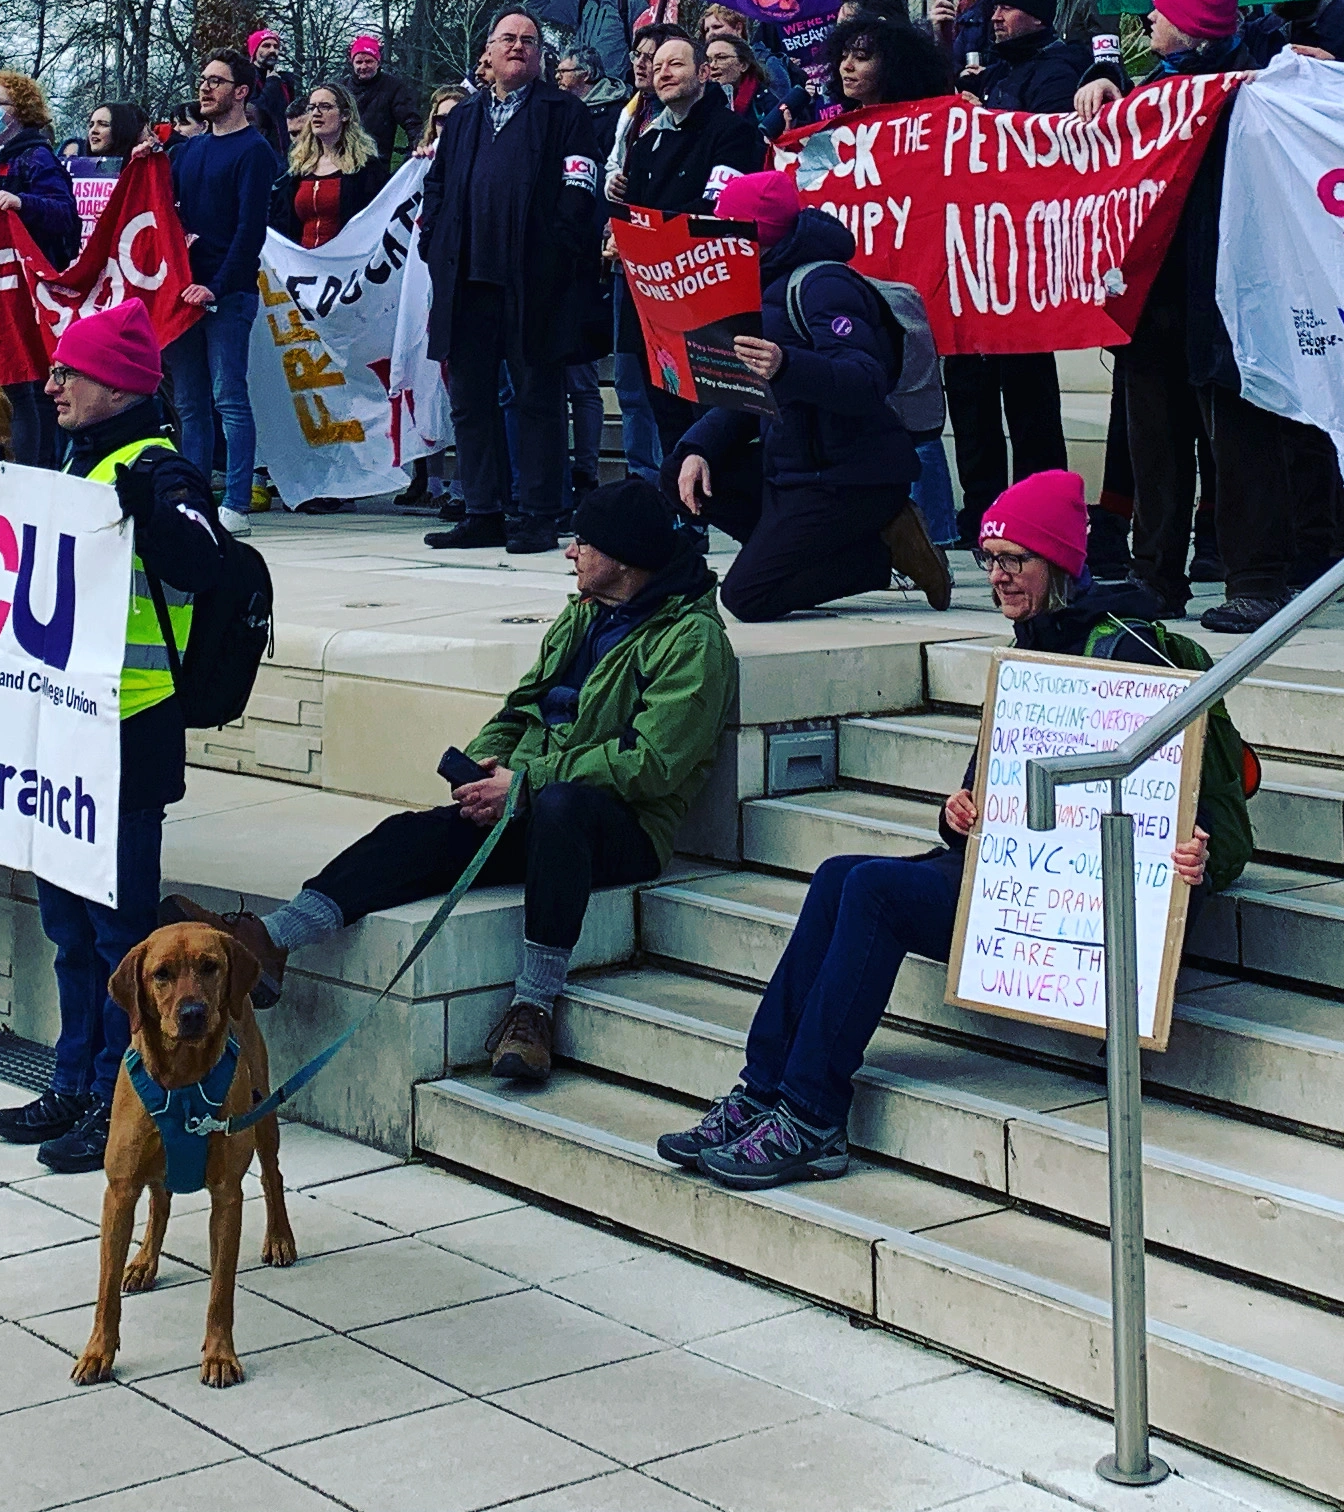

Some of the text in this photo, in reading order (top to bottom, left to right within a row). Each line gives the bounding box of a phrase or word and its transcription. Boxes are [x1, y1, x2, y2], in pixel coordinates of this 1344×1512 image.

[887, 112, 932, 157] THE
[944, 98, 1124, 178] PENSION
[625, 236, 755, 283] FOUR FIGHTS
[945, 202, 1017, 317] NO
[636, 263, 731, 302] ONE VOICE
[0, 669, 24, 691] and
[66, 685, 97, 716] Union
[1001, 666, 1031, 691] OUR
[1034, 672, 1091, 695] STUDENTS
[997, 699, 1022, 721] OUR
[1025, 704, 1087, 730] TEACHING
[993, 727, 1020, 756] OUR
[1023, 726, 1091, 746] PROFESSIONAL
[990, 758, 1022, 787] OUR
[987, 794, 1020, 826] OUR
[980, 833, 1018, 868] OUR
[1029, 843, 1064, 874] VC
[983, 876, 1039, 907] WE'RE
[999, 909, 1100, 938] THE LIN
[976, 935, 1102, 973] WE ARE TH
